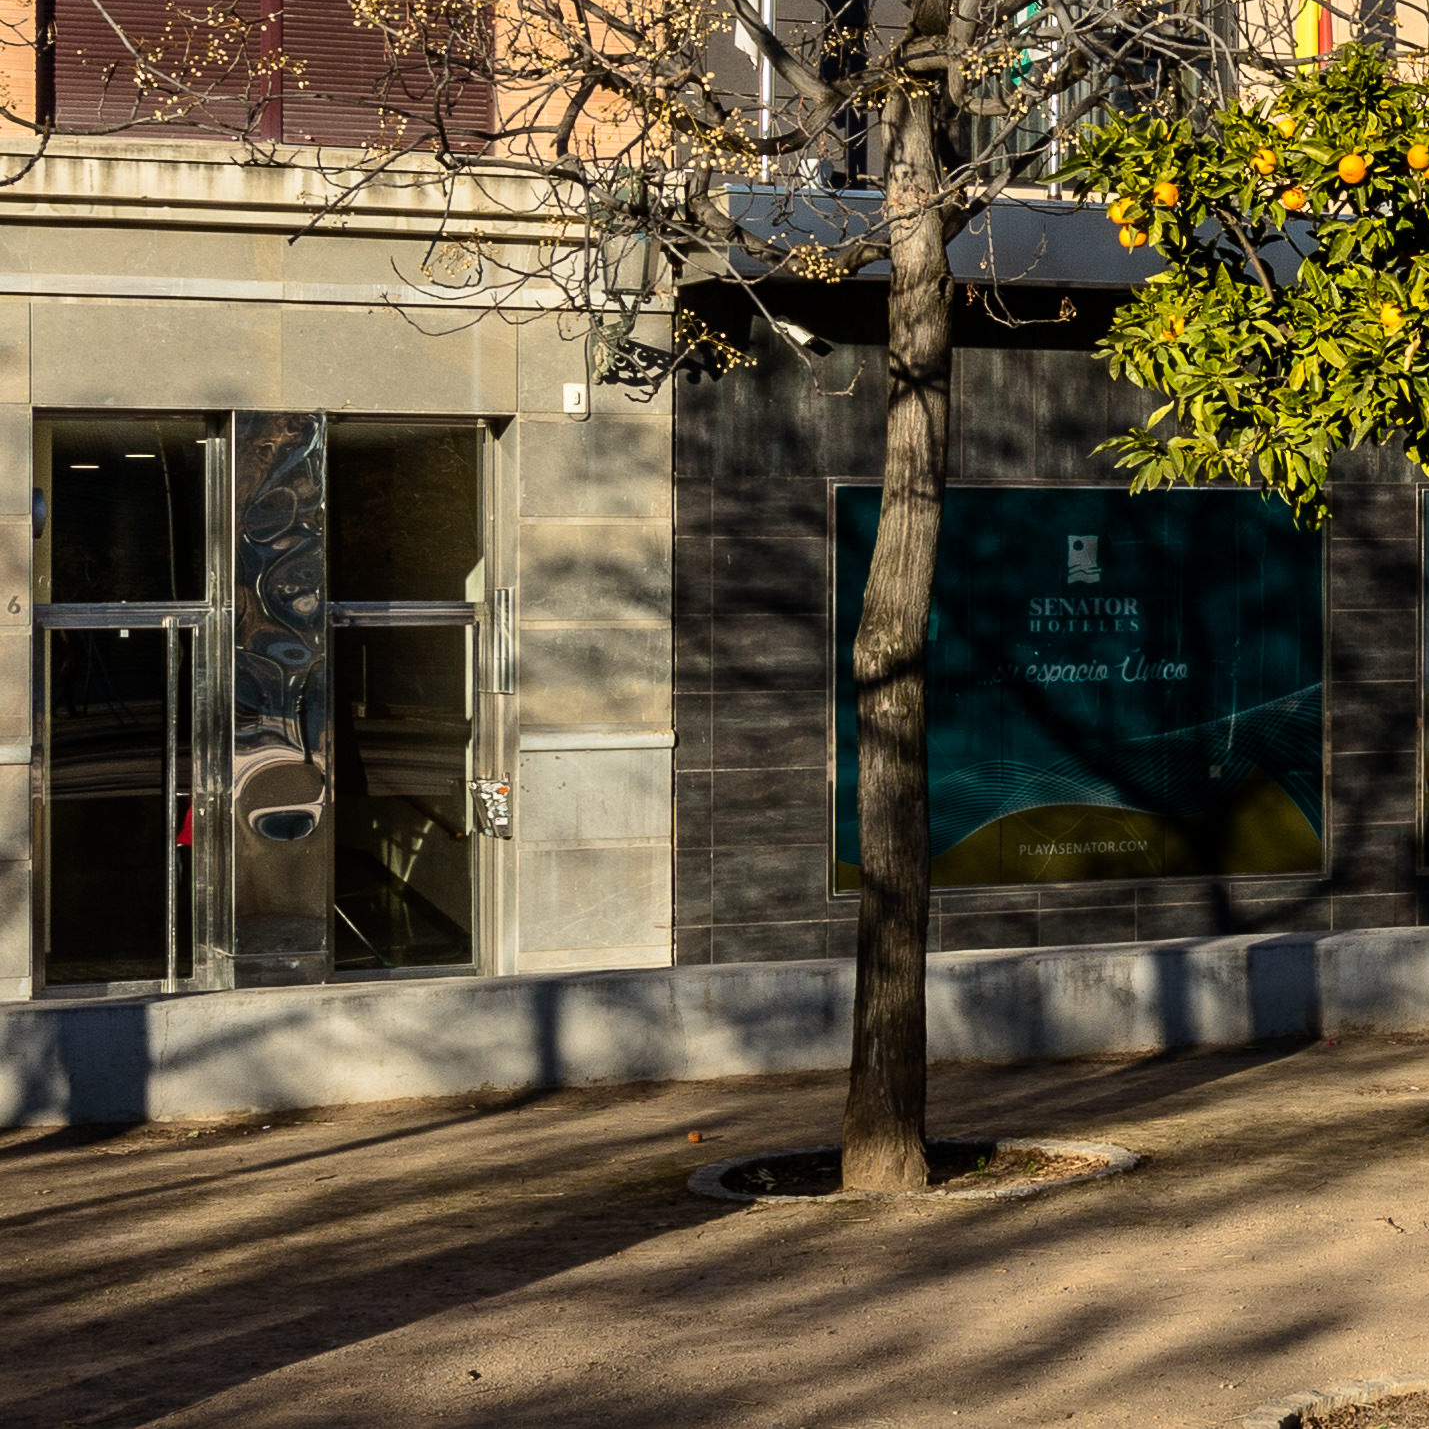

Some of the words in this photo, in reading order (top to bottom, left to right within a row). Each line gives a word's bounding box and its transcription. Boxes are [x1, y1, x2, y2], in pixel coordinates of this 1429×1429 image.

[7, 595, 21, 614] 6
[1028, 597, 1139, 616] SENATOR
[1029, 618, 1140, 633] HOTELES
[1024, 658, 1110, 690] espacio
[1114, 646, 1191, 683] Único
[1018, 839, 1148, 856] PLAYASENATOR.COM
